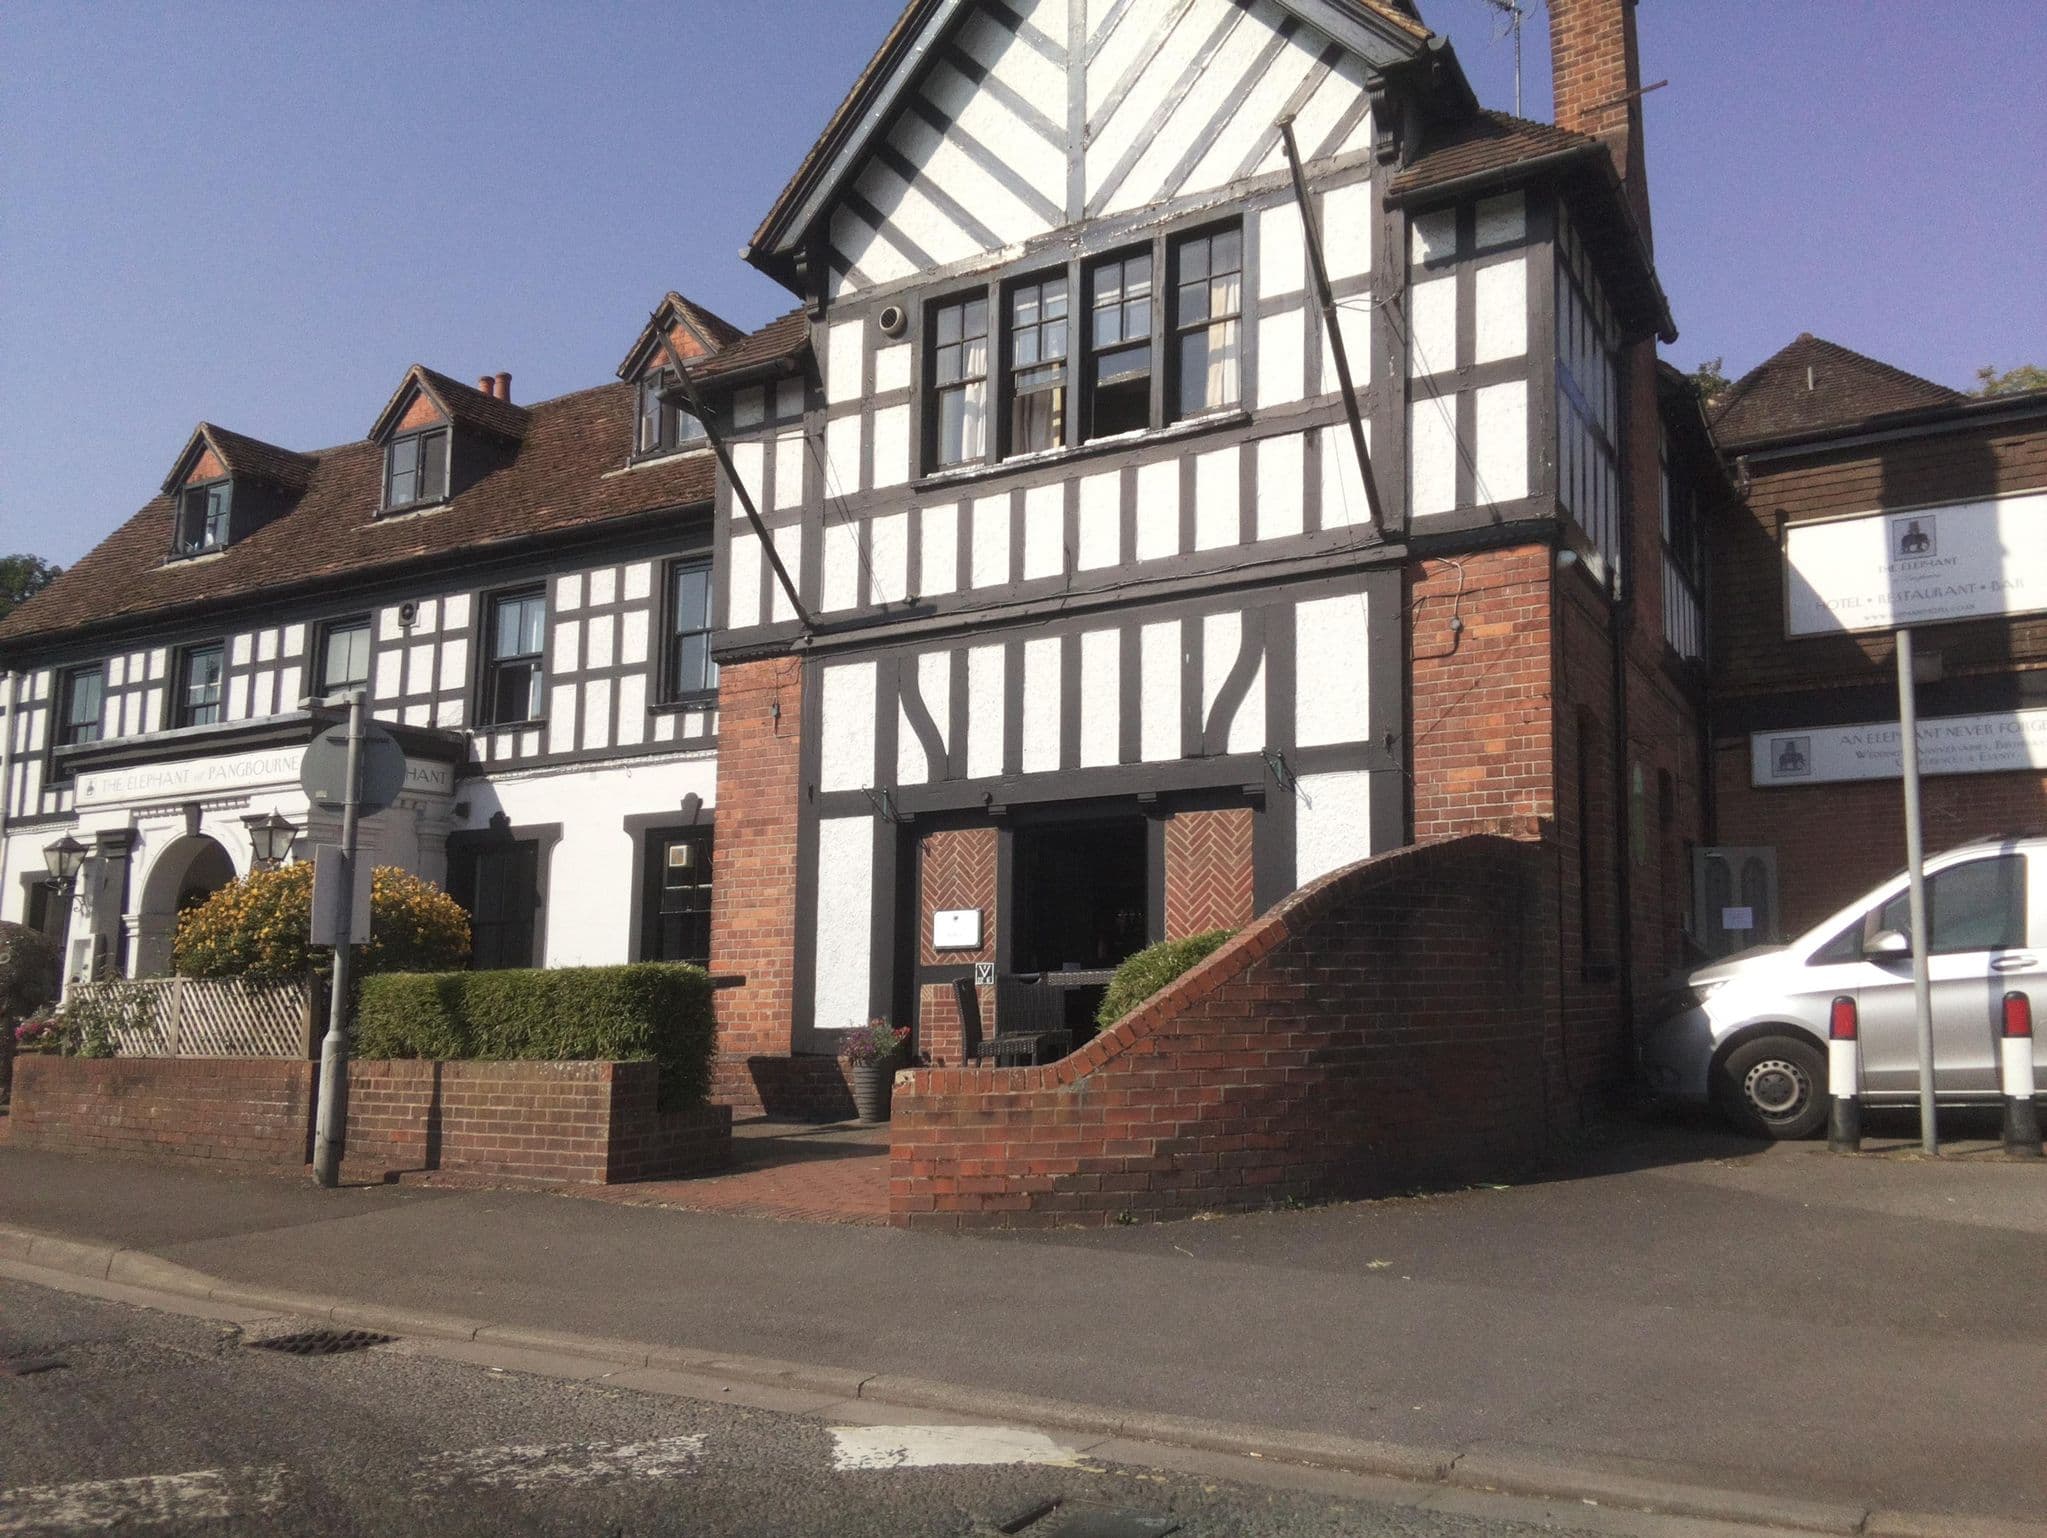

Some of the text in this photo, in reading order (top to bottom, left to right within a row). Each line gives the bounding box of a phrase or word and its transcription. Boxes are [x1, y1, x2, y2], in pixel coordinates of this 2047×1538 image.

[1815, 577, 2025, 611] HOTEL RESTAURANT BAR
[1840, 734, 1863, 746] AN
[1867, 726, 1943, 744] ELEPANT
[1945, 723, 1993, 739] NEVER
[101, 777, 122, 793] THE
[126, 768, 191, 791] ELEPHANT
[208, 755, 298, 782] PANGBOURNE
